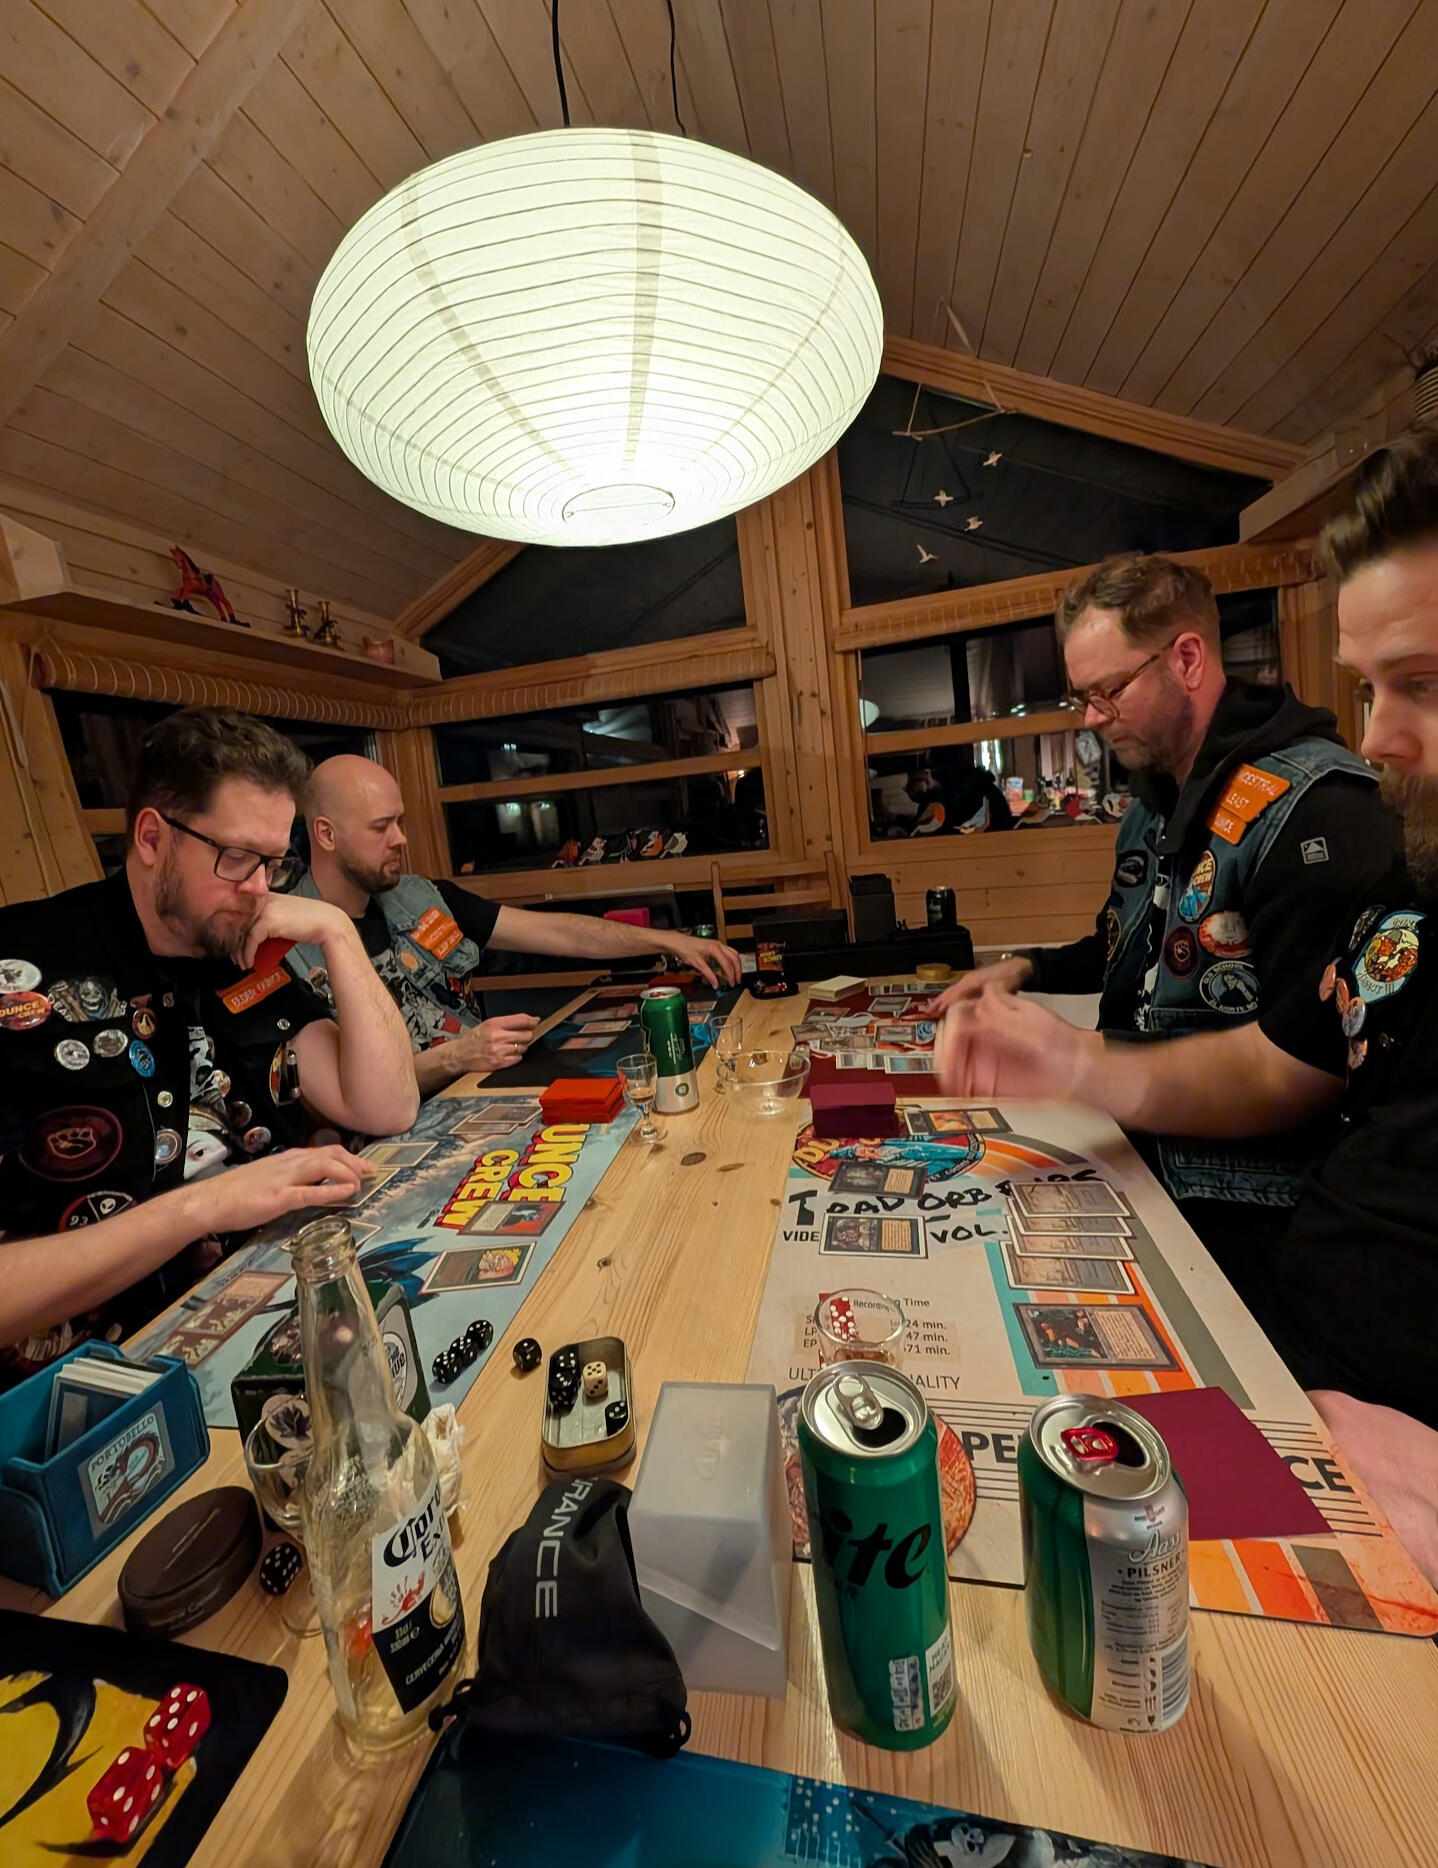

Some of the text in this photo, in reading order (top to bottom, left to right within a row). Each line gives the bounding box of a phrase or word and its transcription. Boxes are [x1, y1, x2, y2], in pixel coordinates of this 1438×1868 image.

[438, 1149, 520, 1227] CREW
[917, 1187, 993, 1212] ORB
[904, 1298, 930, 1308] Time
[804, 1326, 818, 1337] LP
[923, 1333, 949, 1343] min.
[922, 1321, 947, 1330] min.
[803, 1338, 818, 1348] EP
[925, 1345, 951, 1355] min.
[90, 1414, 155, 1472] PORTOBELLO
[960, 1431, 1022, 1463] PE
[534, 1479, 593, 1619] RANCE
[1127, 1554, 1183, 1579] PILSNER
